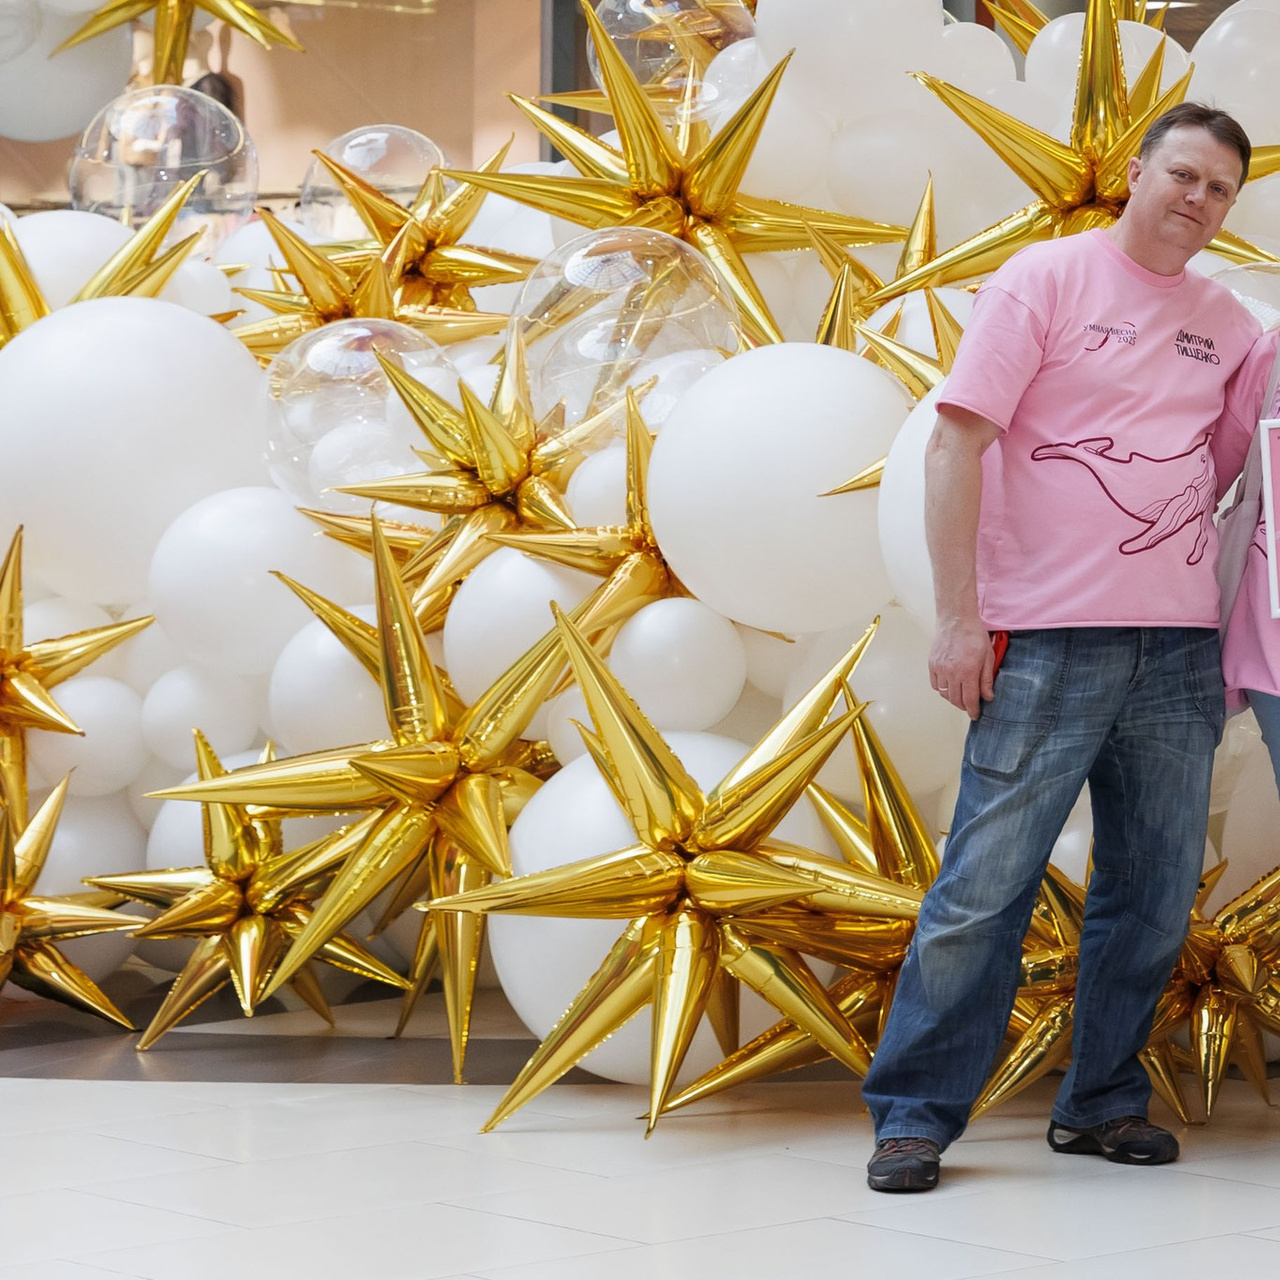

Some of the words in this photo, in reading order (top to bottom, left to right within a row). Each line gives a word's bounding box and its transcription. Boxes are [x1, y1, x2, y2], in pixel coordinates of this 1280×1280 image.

[1111, 329, 1137, 337] ВЕСНА
[1117, 336, 1137, 346] 2025
[1176, 329, 1215, 351] ДМИТРИЙ
[1174, 343, 1220, 365] ТИЩЕНКО
